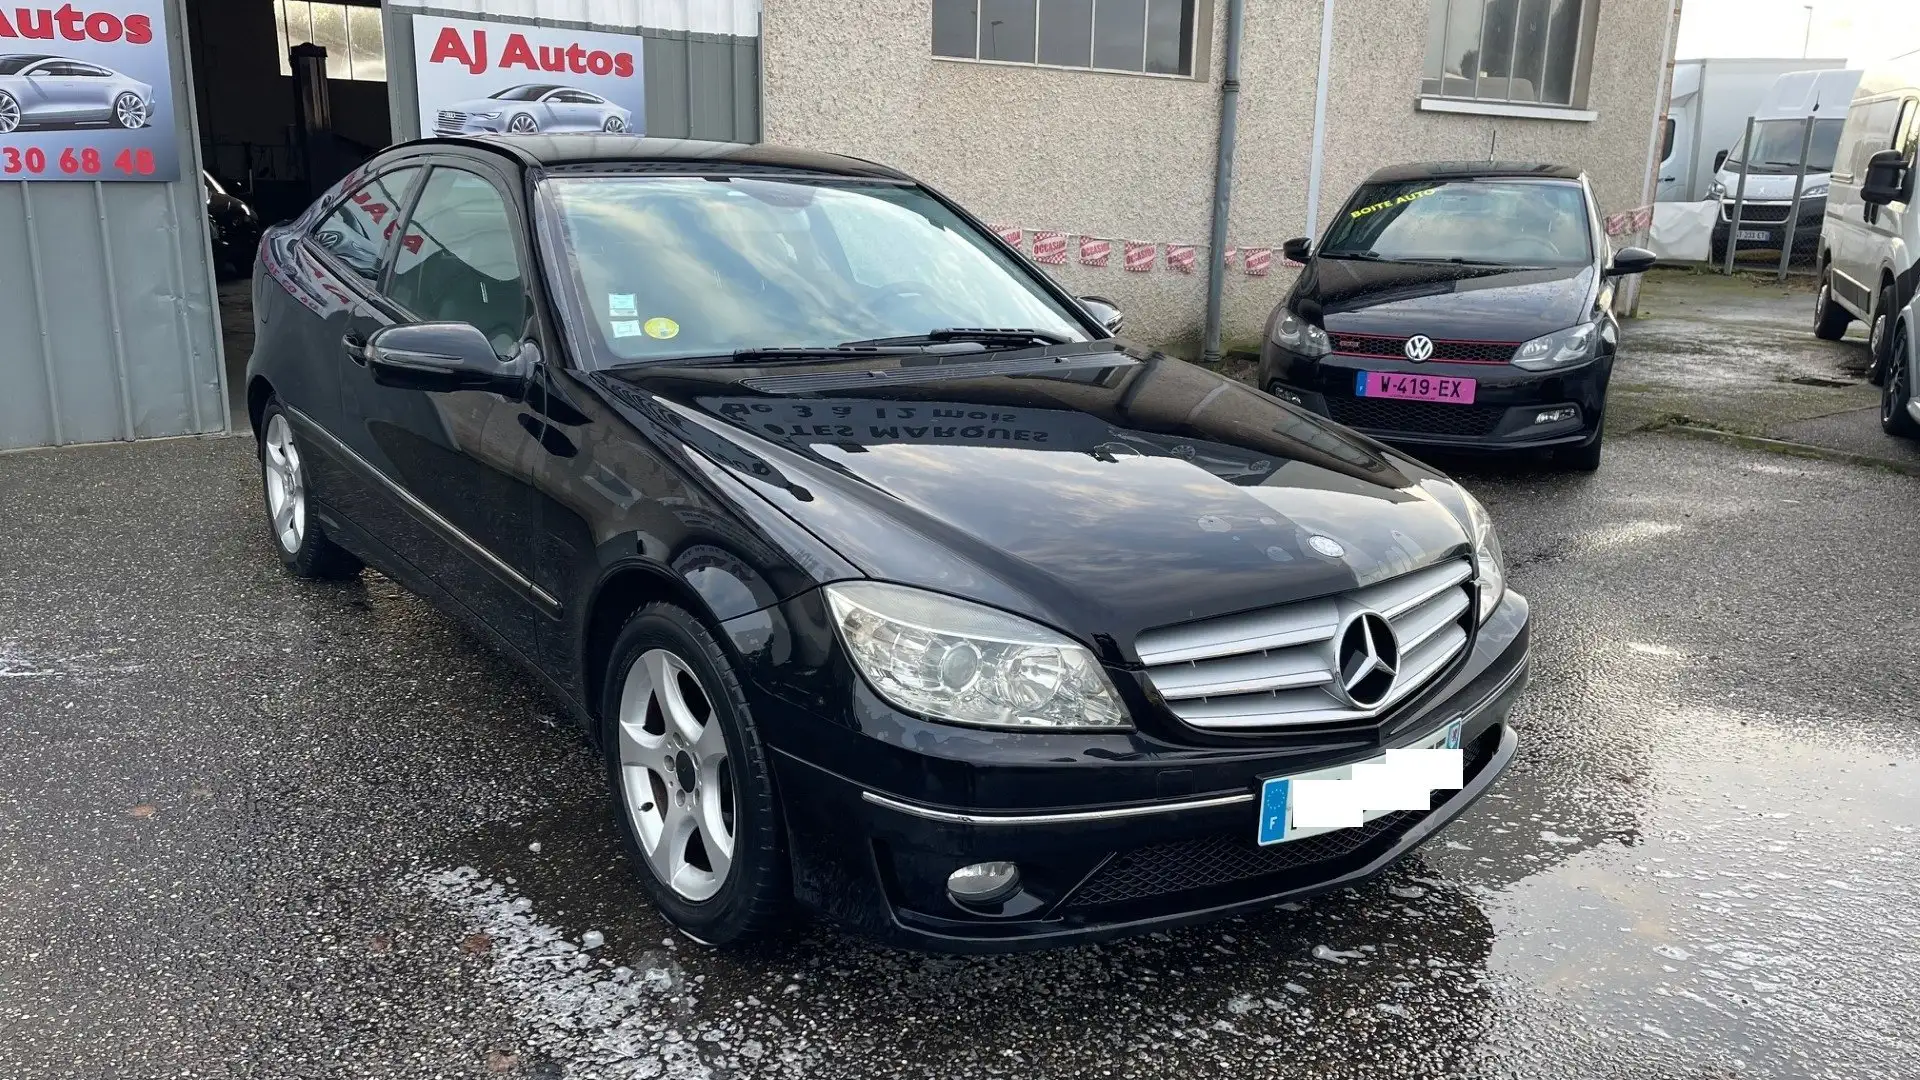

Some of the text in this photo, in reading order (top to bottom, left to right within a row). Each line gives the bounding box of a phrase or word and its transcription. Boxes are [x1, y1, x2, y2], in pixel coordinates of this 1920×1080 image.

[429, 26, 635, 78] AJ Autos
[2, 147, 46, 174] 30
[59, 147, 101, 175] 68
[1350, 188, 1436, 218] BOITE AUTO
[1380, 375, 1462, 398] W-419-EX
[1269, 816, 1278, 830] F
